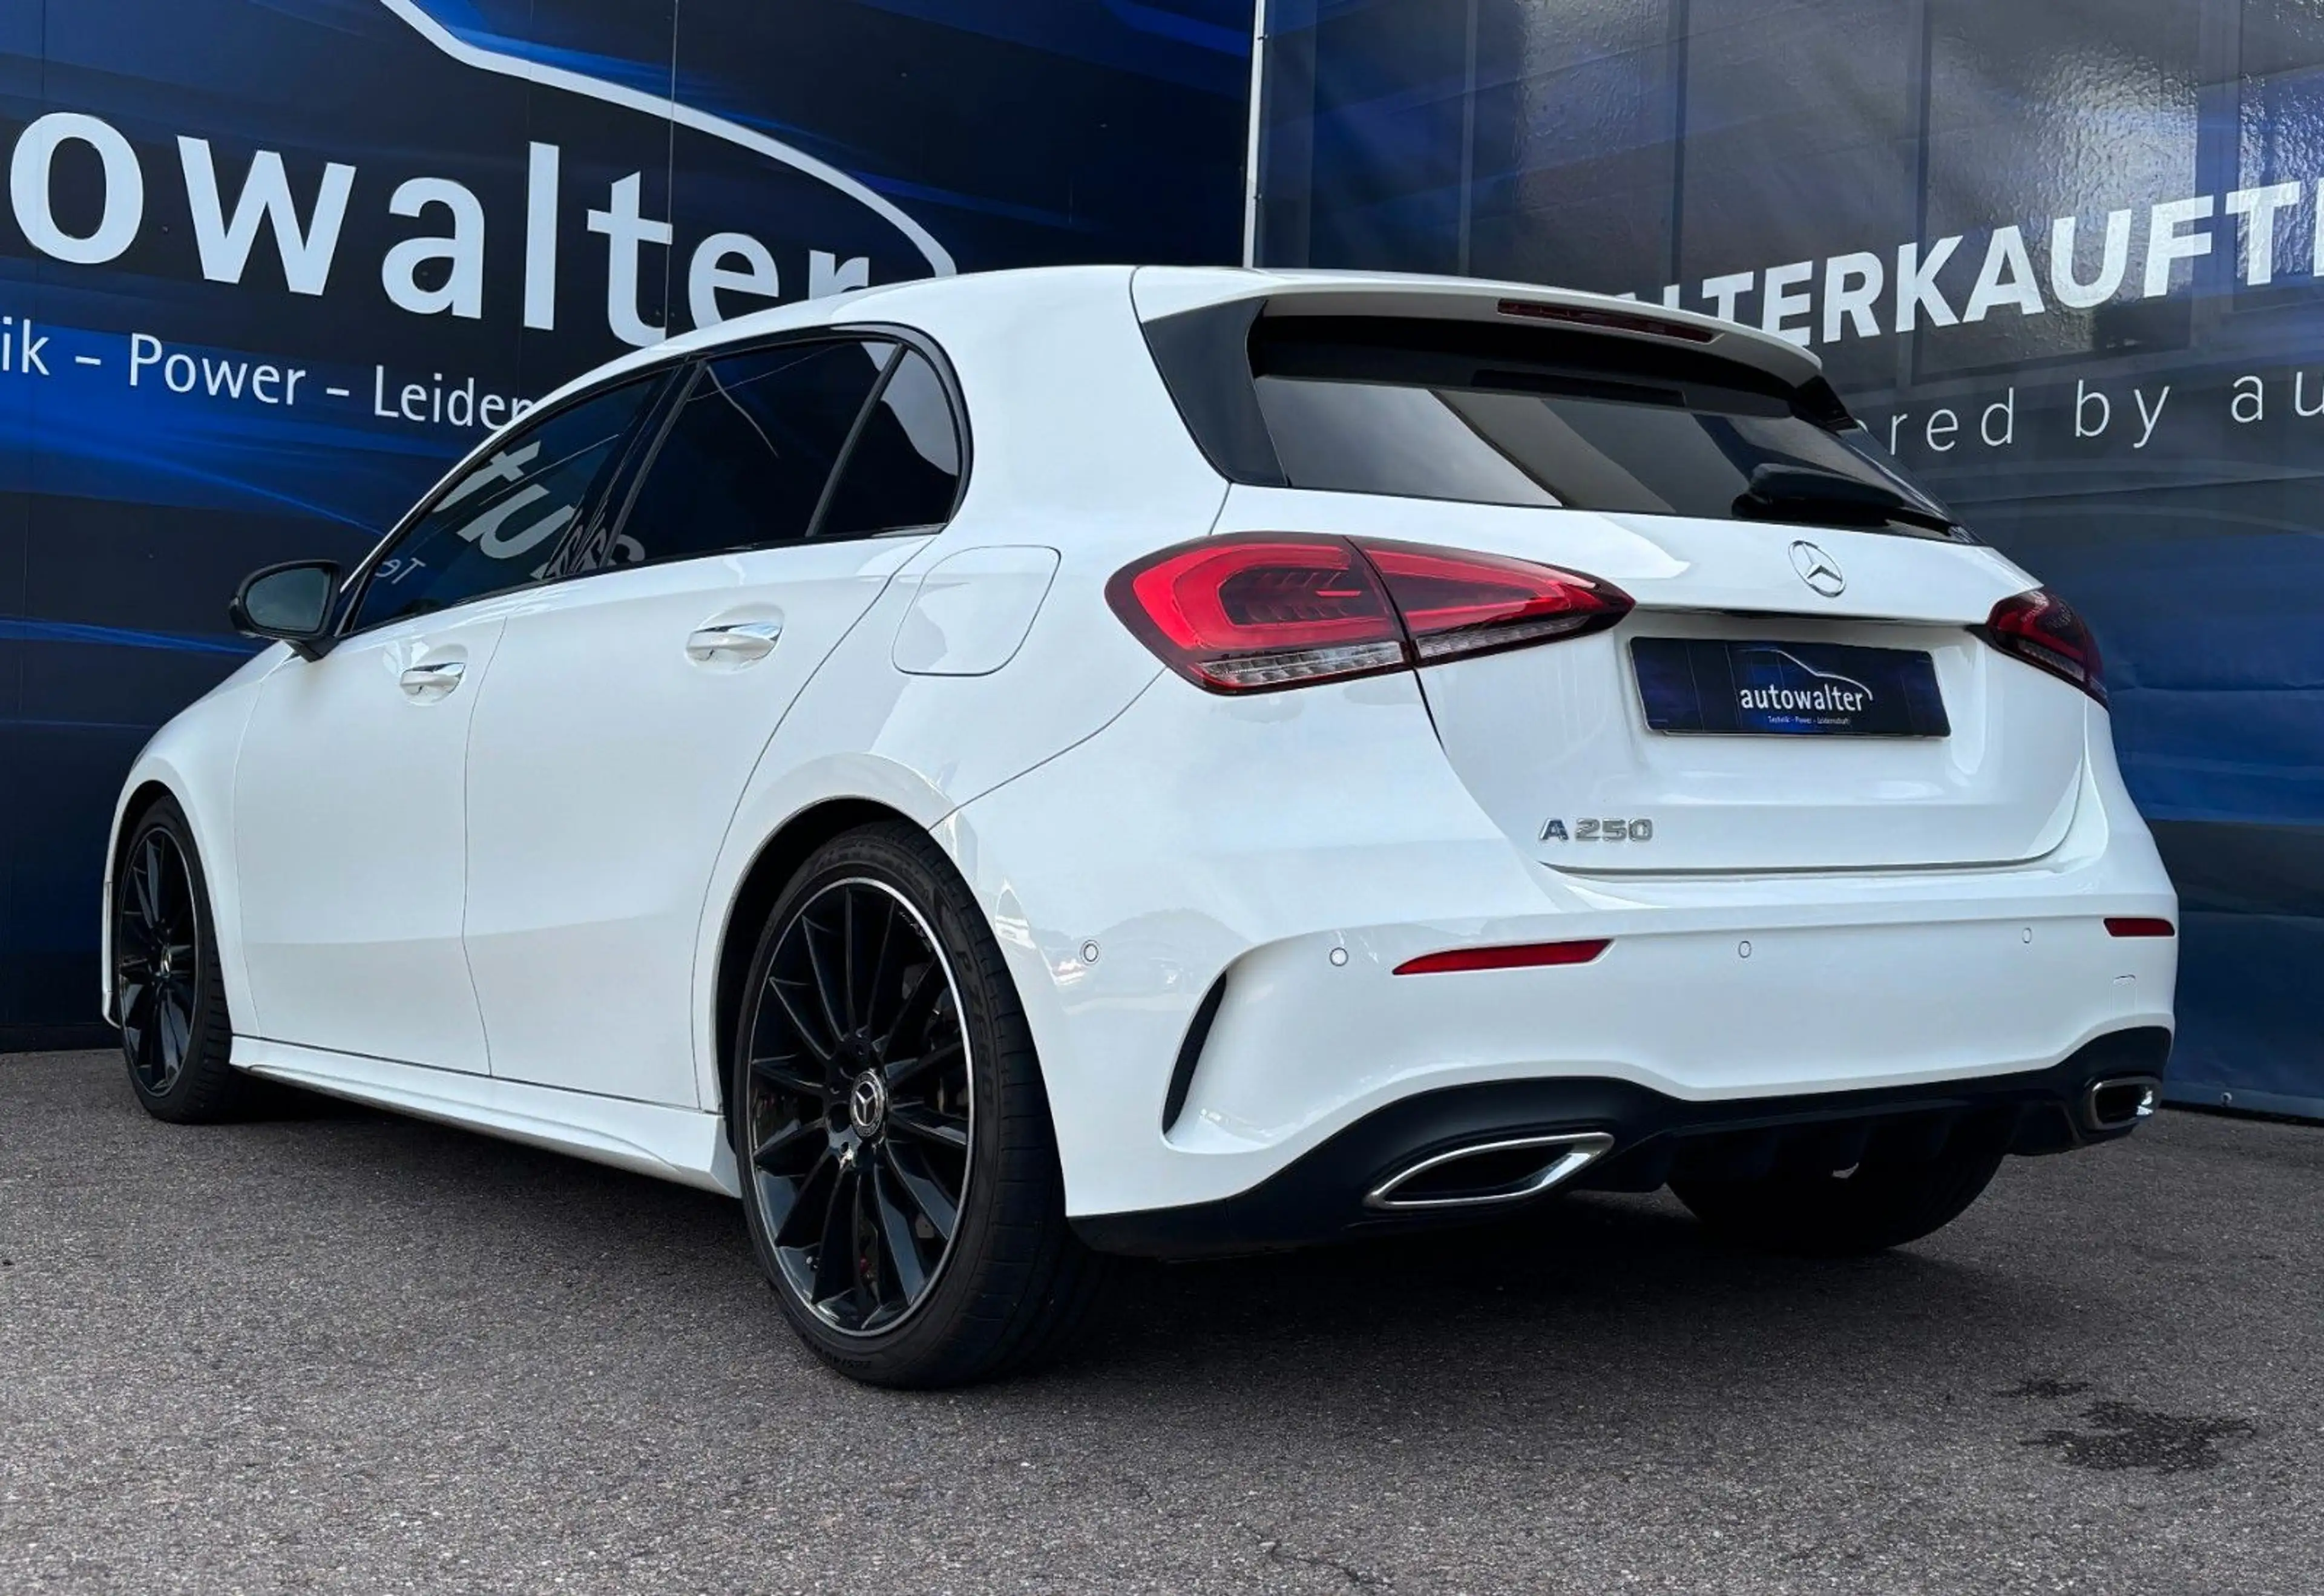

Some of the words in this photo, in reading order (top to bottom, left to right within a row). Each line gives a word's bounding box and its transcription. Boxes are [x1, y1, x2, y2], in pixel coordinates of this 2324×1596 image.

[130, 332, 306, 405] Power
[1856, 387, 2014, 456] red
[2074, 379, 2171, 449] by
[1740, 683, 1862, 711] autowalter
[1539, 818, 1569, 841] A
[1575, 818, 1654, 842] 250
